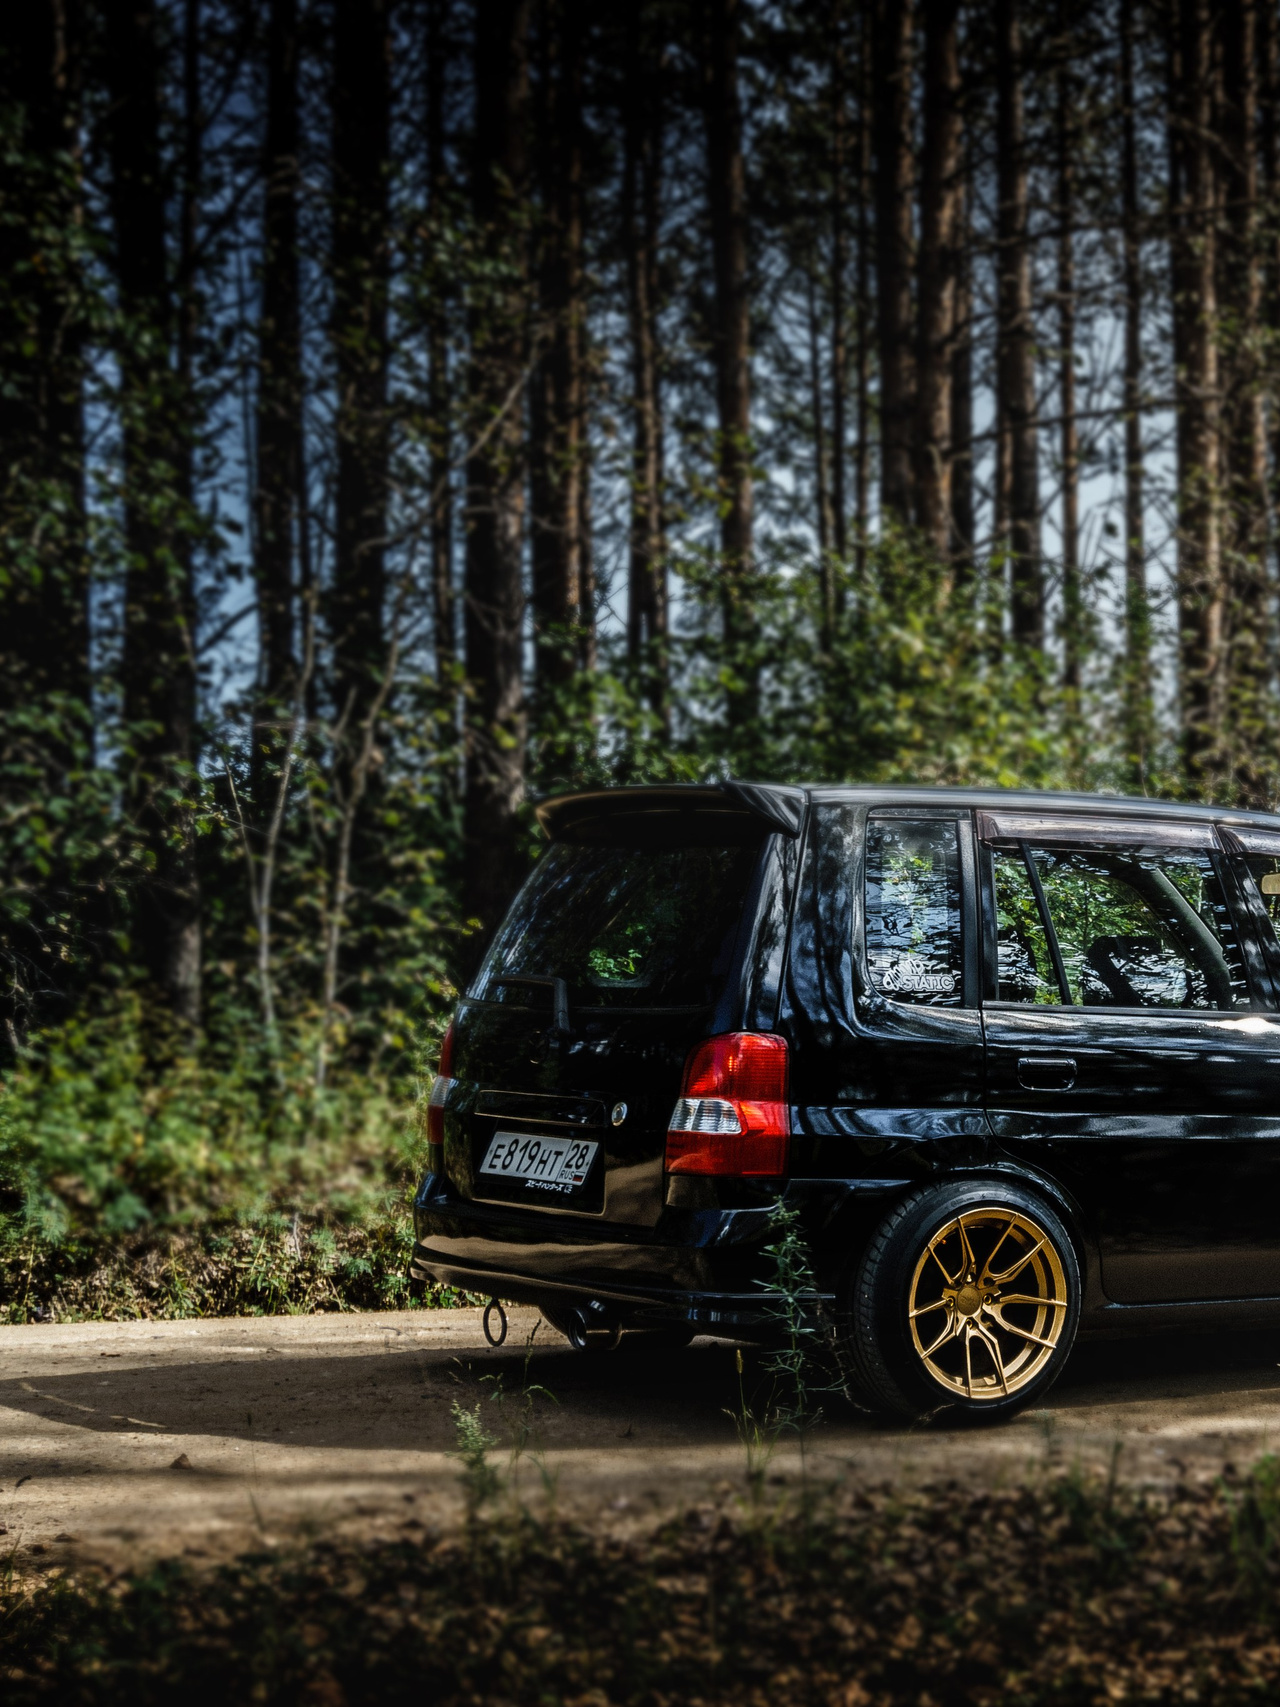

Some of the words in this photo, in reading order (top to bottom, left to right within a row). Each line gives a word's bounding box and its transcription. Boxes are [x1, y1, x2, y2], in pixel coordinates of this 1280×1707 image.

[902, 975, 955, 991] STATIC
[564, 1143, 589, 1170] 28
[559, 1169, 574, 1180] RUS
